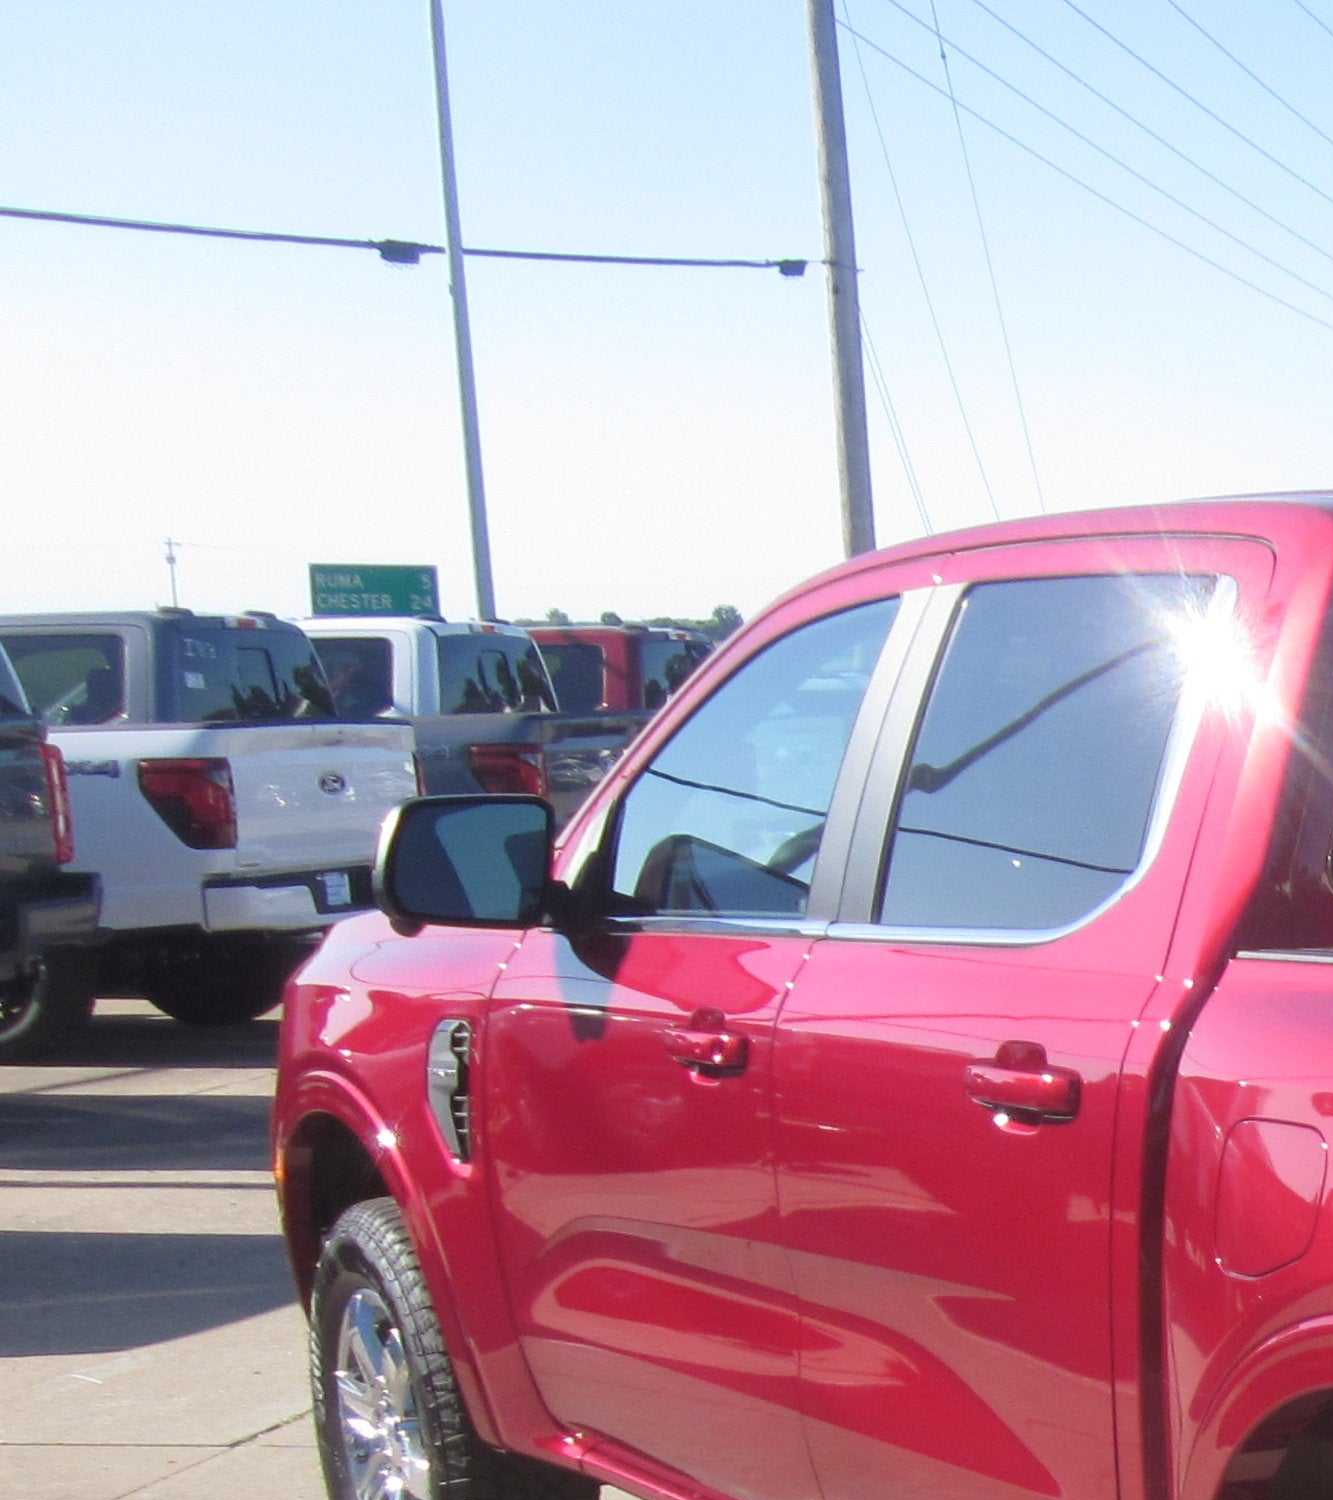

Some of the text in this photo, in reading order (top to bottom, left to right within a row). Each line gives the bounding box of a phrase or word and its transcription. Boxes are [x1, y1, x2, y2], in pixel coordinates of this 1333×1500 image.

[314, 571, 433, 590] RUMA 5
[317, 592, 434, 611] CHESTER 24
